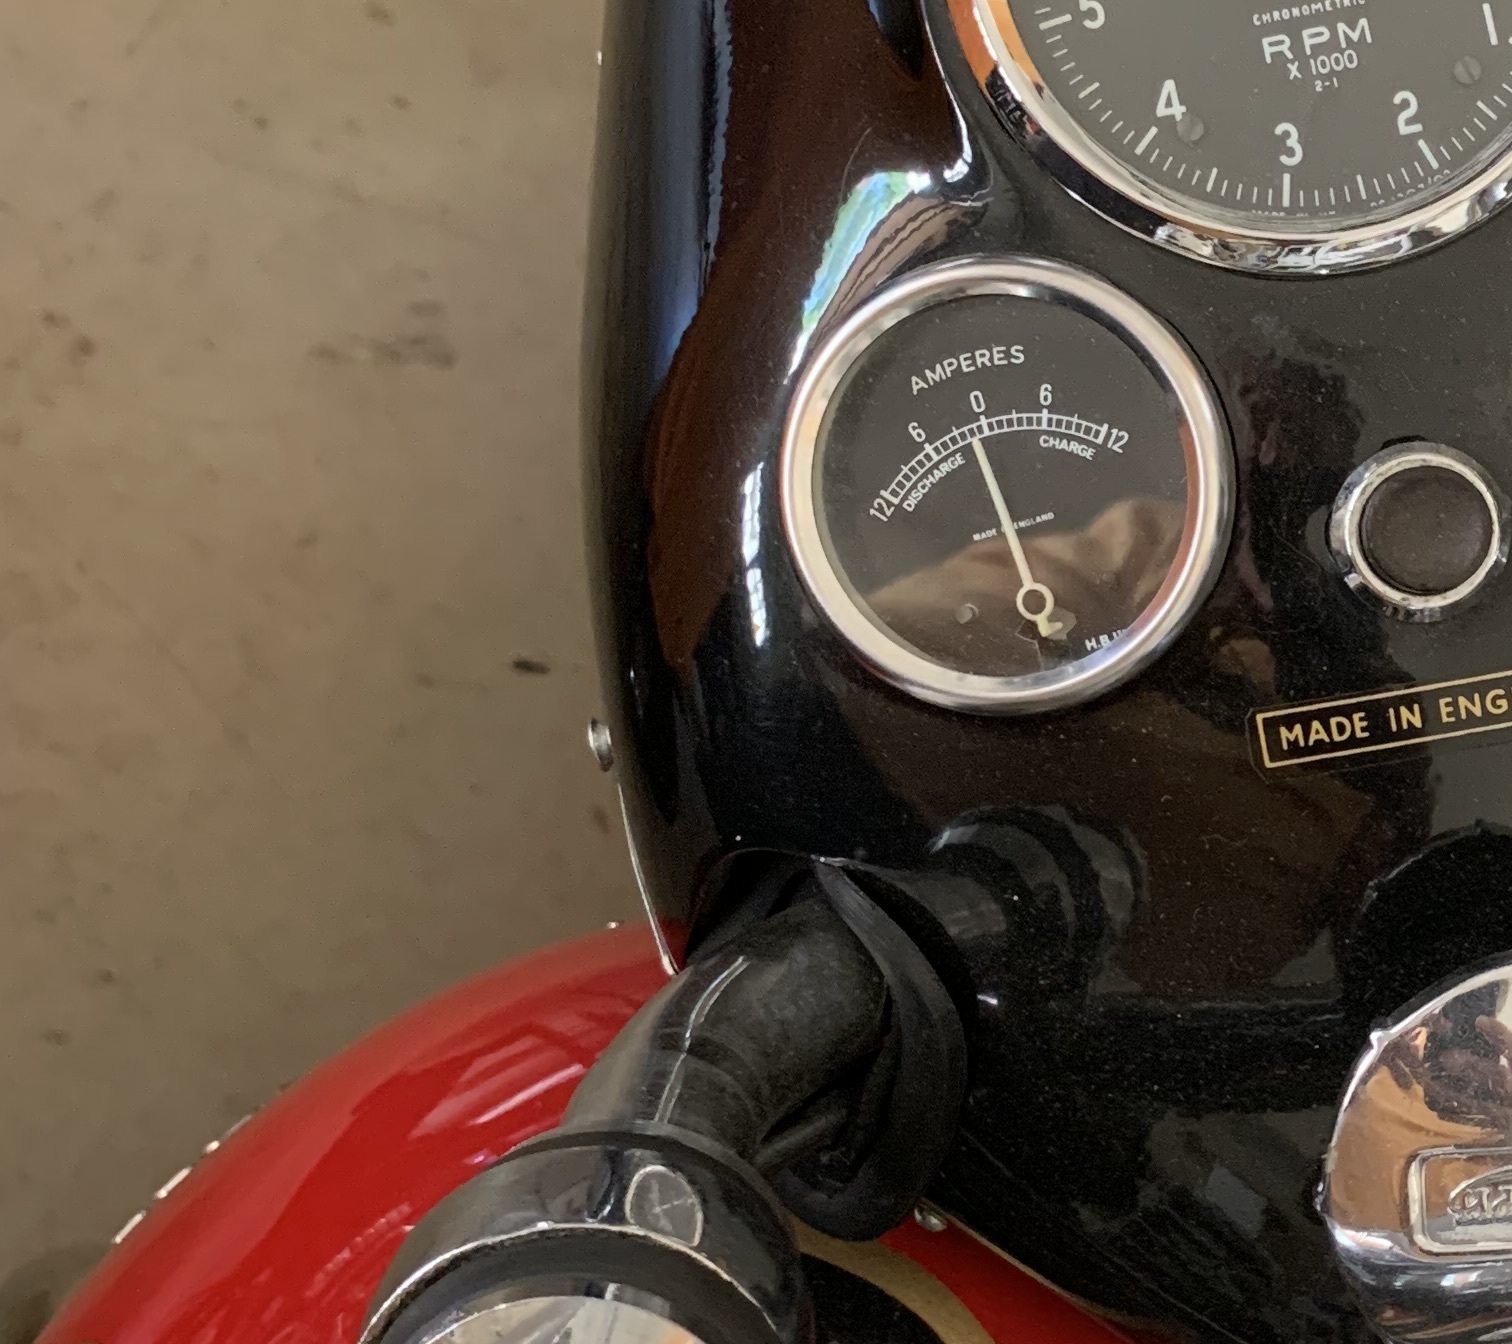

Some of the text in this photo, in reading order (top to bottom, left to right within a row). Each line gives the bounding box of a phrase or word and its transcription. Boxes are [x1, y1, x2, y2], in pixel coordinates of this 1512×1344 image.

[1482, 2, 1499, 46] 1
[1261, 17, 1373, 65] RPM
[1309, 49, 1359, 76] 1000
[1314, 76, 1339, 92] 2-1
[1155, 80, 1187, 121] 4
[1392, 90, 1423, 137] 2
[1274, 123, 1303, 167] 3
[909, 344, 1025, 396] AMPERES
[969, 390, 986, 413] 0
[1039, 383, 1053, 406] 6
[907, 421, 926, 443] 6
[1106, 427, 1129, 454] 12
[1039, 434, 1096, 461] CHARGE
[902, 452, 966, 513] DISCHARGE
[869, 497, 895, 523] 12
[972, 527, 998, 542] MADE
[1279, 711, 1370, 752] MADE
[1388, 703, 1424, 733] IN
